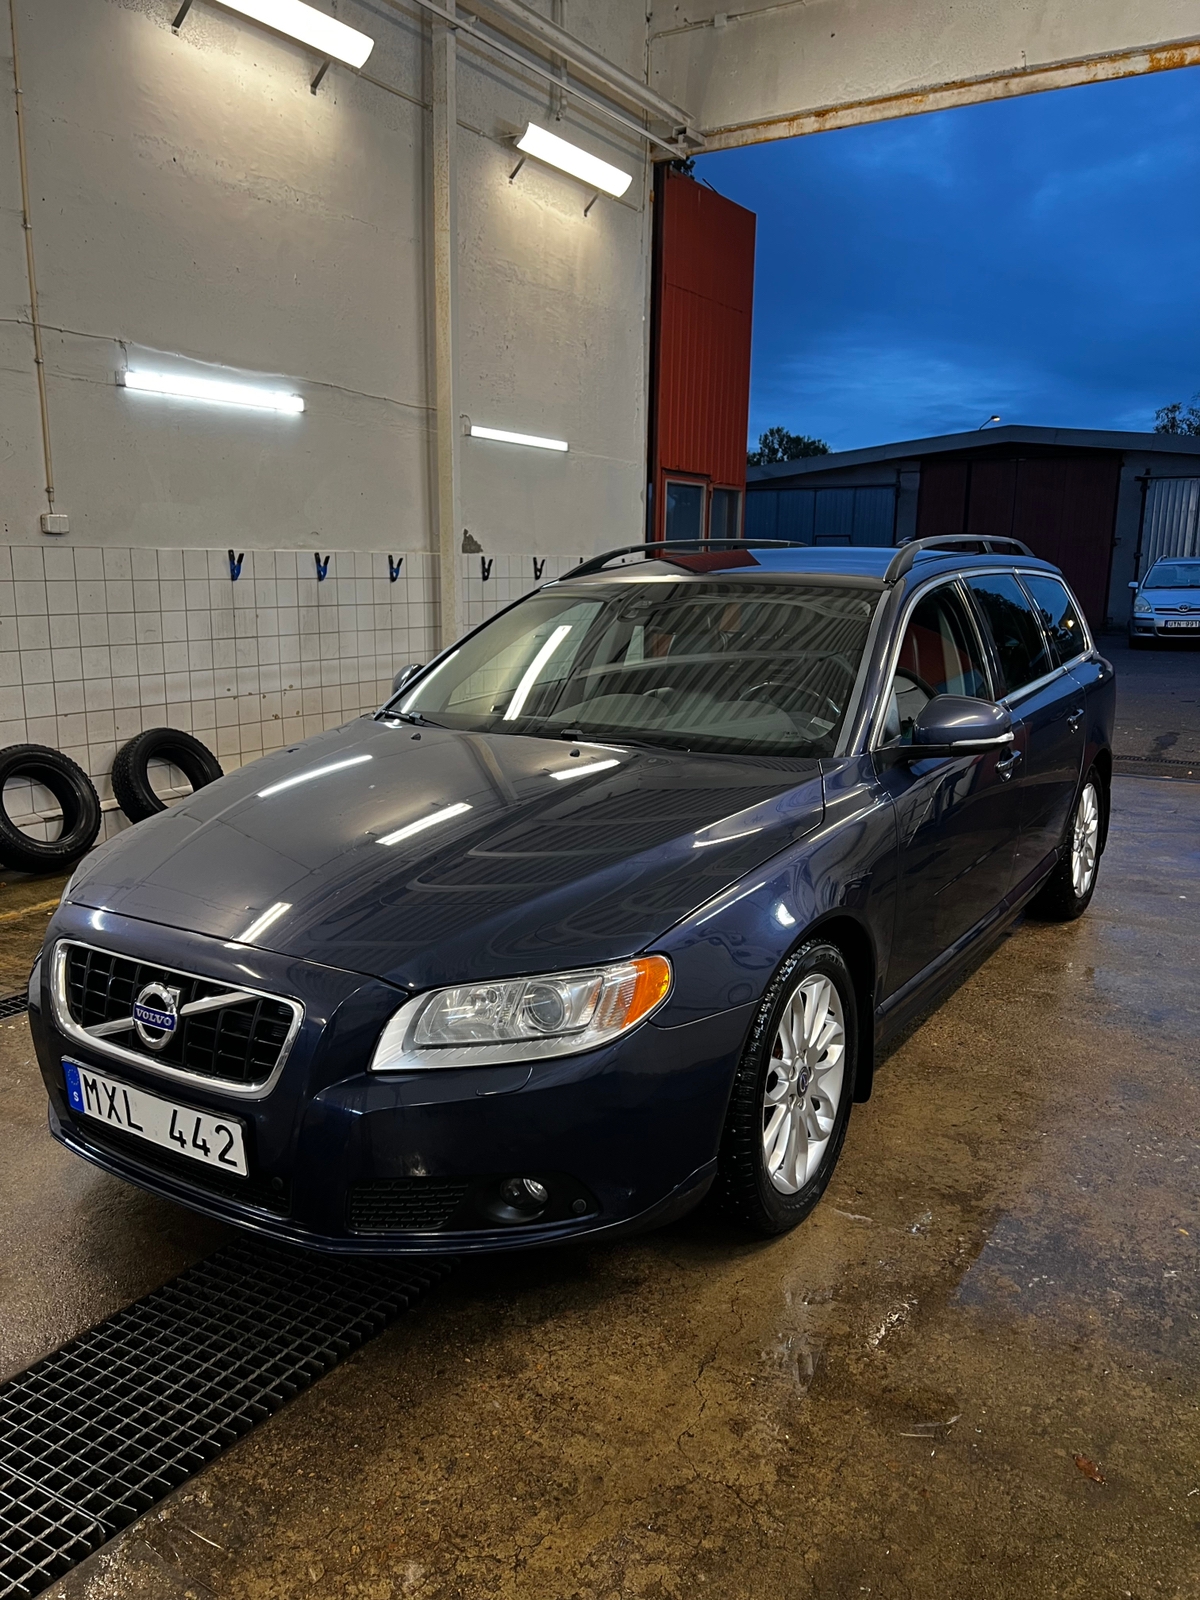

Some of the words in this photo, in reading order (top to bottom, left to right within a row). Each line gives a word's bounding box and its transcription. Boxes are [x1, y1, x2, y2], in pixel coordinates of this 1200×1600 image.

[136, 1007, 172, 1026] VOLVO
[73, 1091, 79, 1102] S
[82, 1073, 143, 1132] MXL
[169, 1109, 238, 1168] 442
